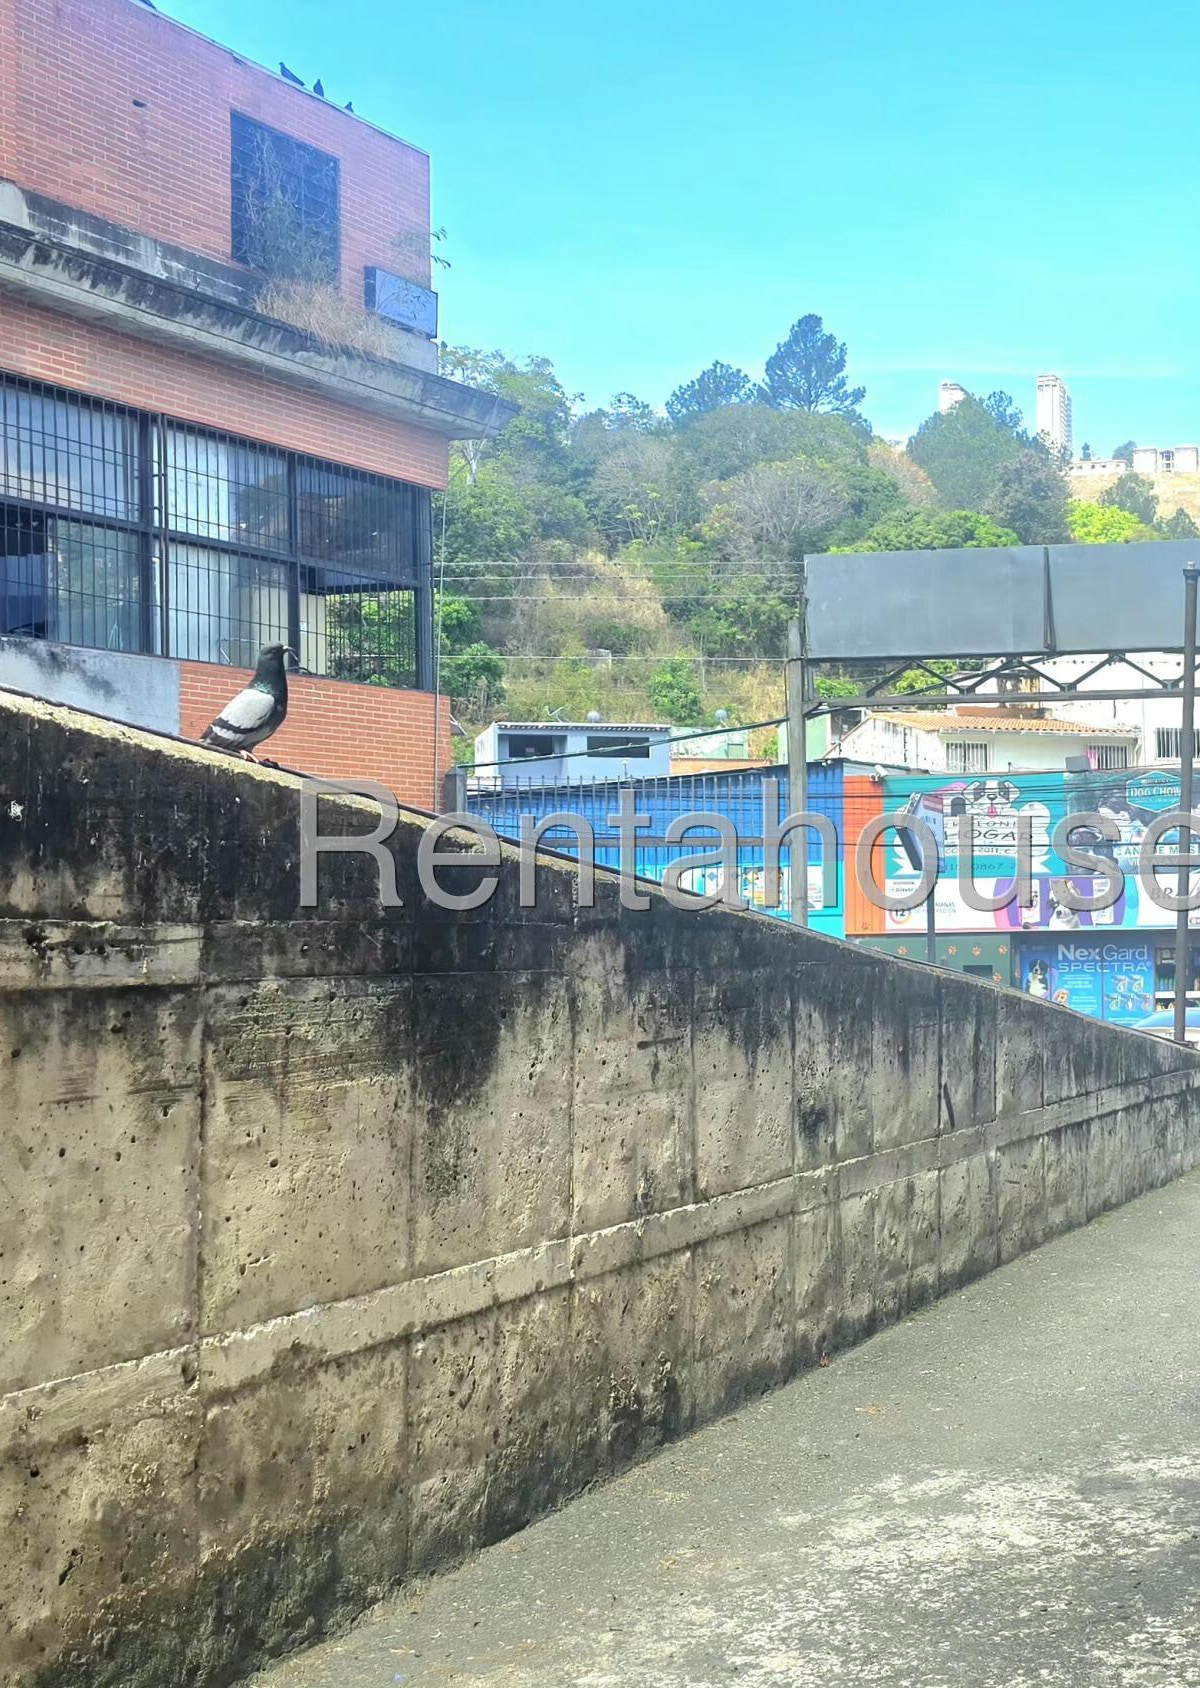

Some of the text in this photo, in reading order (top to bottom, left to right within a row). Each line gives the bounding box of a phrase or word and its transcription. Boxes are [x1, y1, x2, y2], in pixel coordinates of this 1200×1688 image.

[1130, 787, 1151, 797] DOG
[1057, 943, 1148, 961] NexGard
[1058, 962, 1148, 973] SPECTRA
